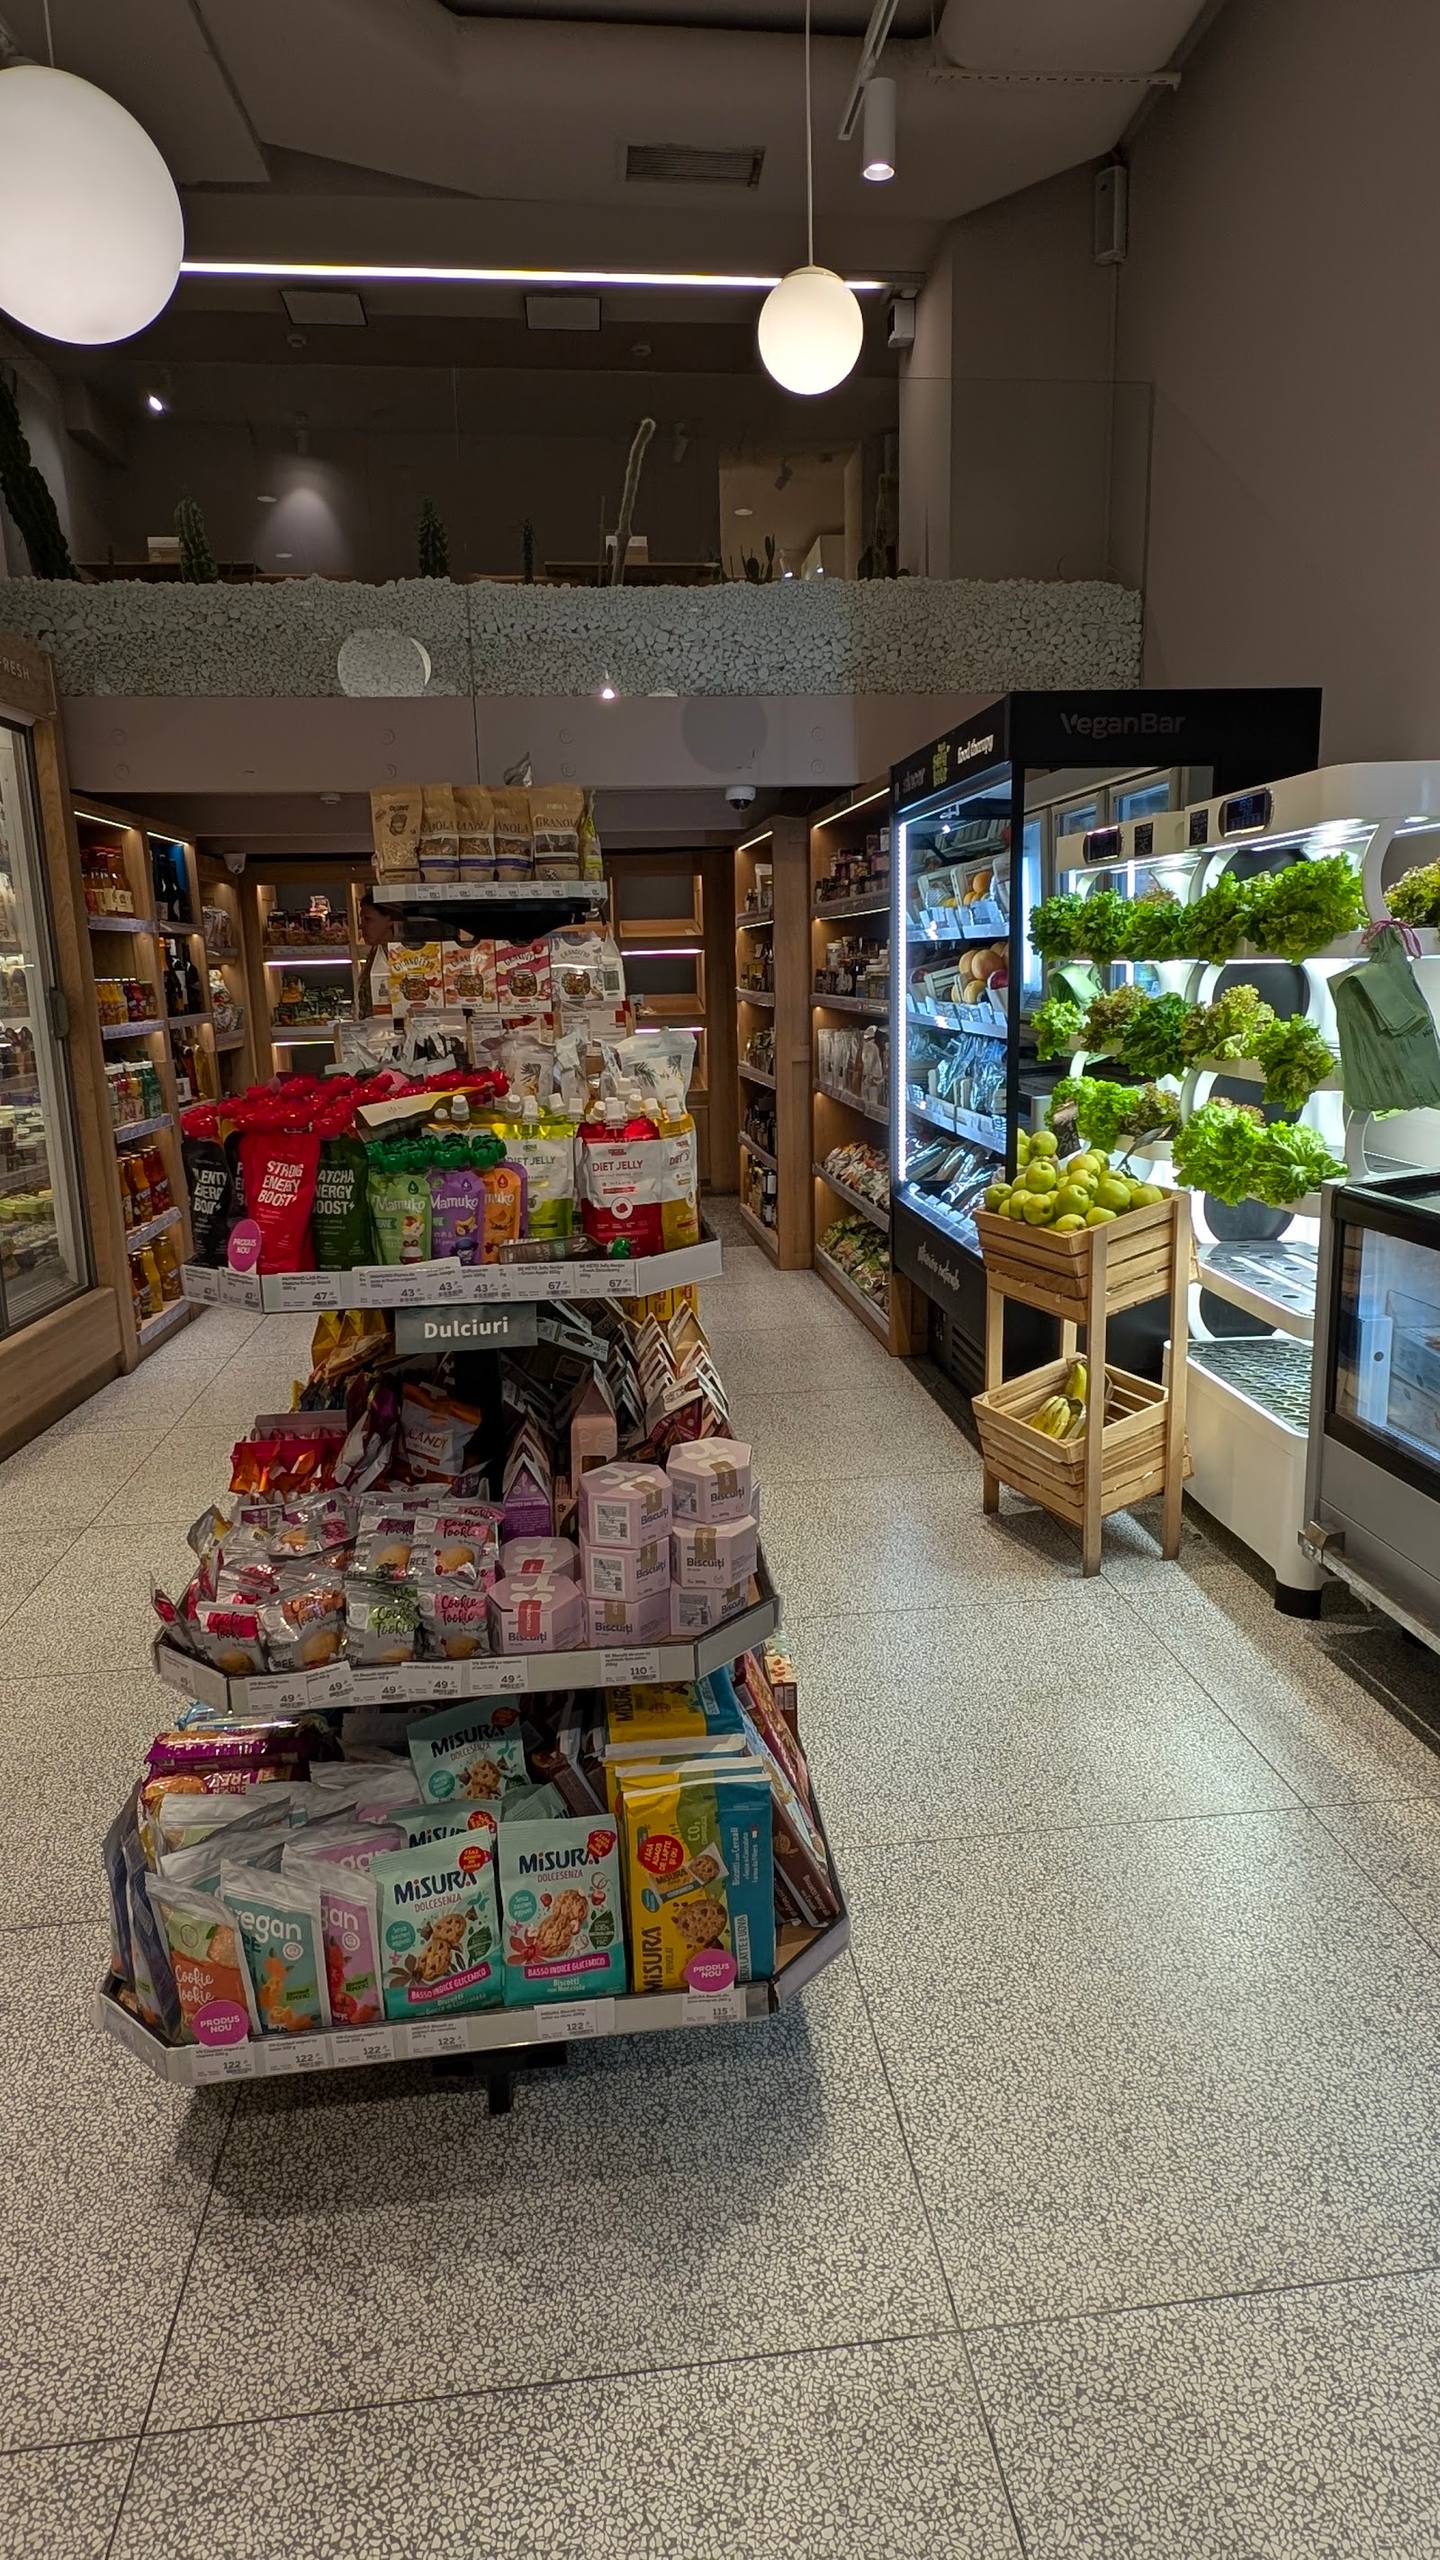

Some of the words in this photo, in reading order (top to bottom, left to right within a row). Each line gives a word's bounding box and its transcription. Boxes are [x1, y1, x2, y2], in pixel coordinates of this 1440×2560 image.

[0, 656, 30, 681] RESH
[1060, 712, 1187, 739] VeganBar
[530, 1155, 556, 1165] JELLY
[592, 1162, 615, 1172] DIET
[616, 1159, 643, 1171] JELLY
[318, 1170, 355, 1184] ATCHA
[439, 1282, 453, 1292] 43
[548, 1281, 561, 1290] 67
[609, 1279, 621, 1288] 67
[400, 1288, 415, 1297] 43
[474, 1284, 488, 1293] 43
[314, 1292, 328, 1300] 47
[424, 1316, 509, 1339] Dulciuri
[630, 1667, 647, 1675] 110
[501, 1675, 515, 1683] 49
[328, 1682, 343, 1692] 49
[434, 1680, 448, 1689] 49
[382, 1686, 396, 1695] 49
[280, 1694, 295, 1703] 49
[537, 1870, 584, 1883] DOLCESENZA
[415, 1894, 462, 1913] DOLCESENZA
[528, 1967, 550, 1977] BASSO
[550, 1963, 572, 1974] INDICE
[572, 1958, 606, 1971] GLICEMICO
[693, 1962, 730, 1973] PRODUS
[174, 1964, 215, 1985] Cookie
[700, 1969, 722, 1978] NOU
[411, 1990, 432, 2000] BASSO
[454, 1967, 487, 1988] GLICEMICO
[711, 2007, 728, 2016] 115
[200, 2015, 240, 2028] PRODUS
[210, 2024, 232, 2034] NOU
[566, 2022, 583, 2031] 122
[438, 2037, 455, 2046] 122
[363, 2046, 380, 2055] 122
[296, 2054, 313, 2063] 122
[223, 2060, 241, 2069] 122
